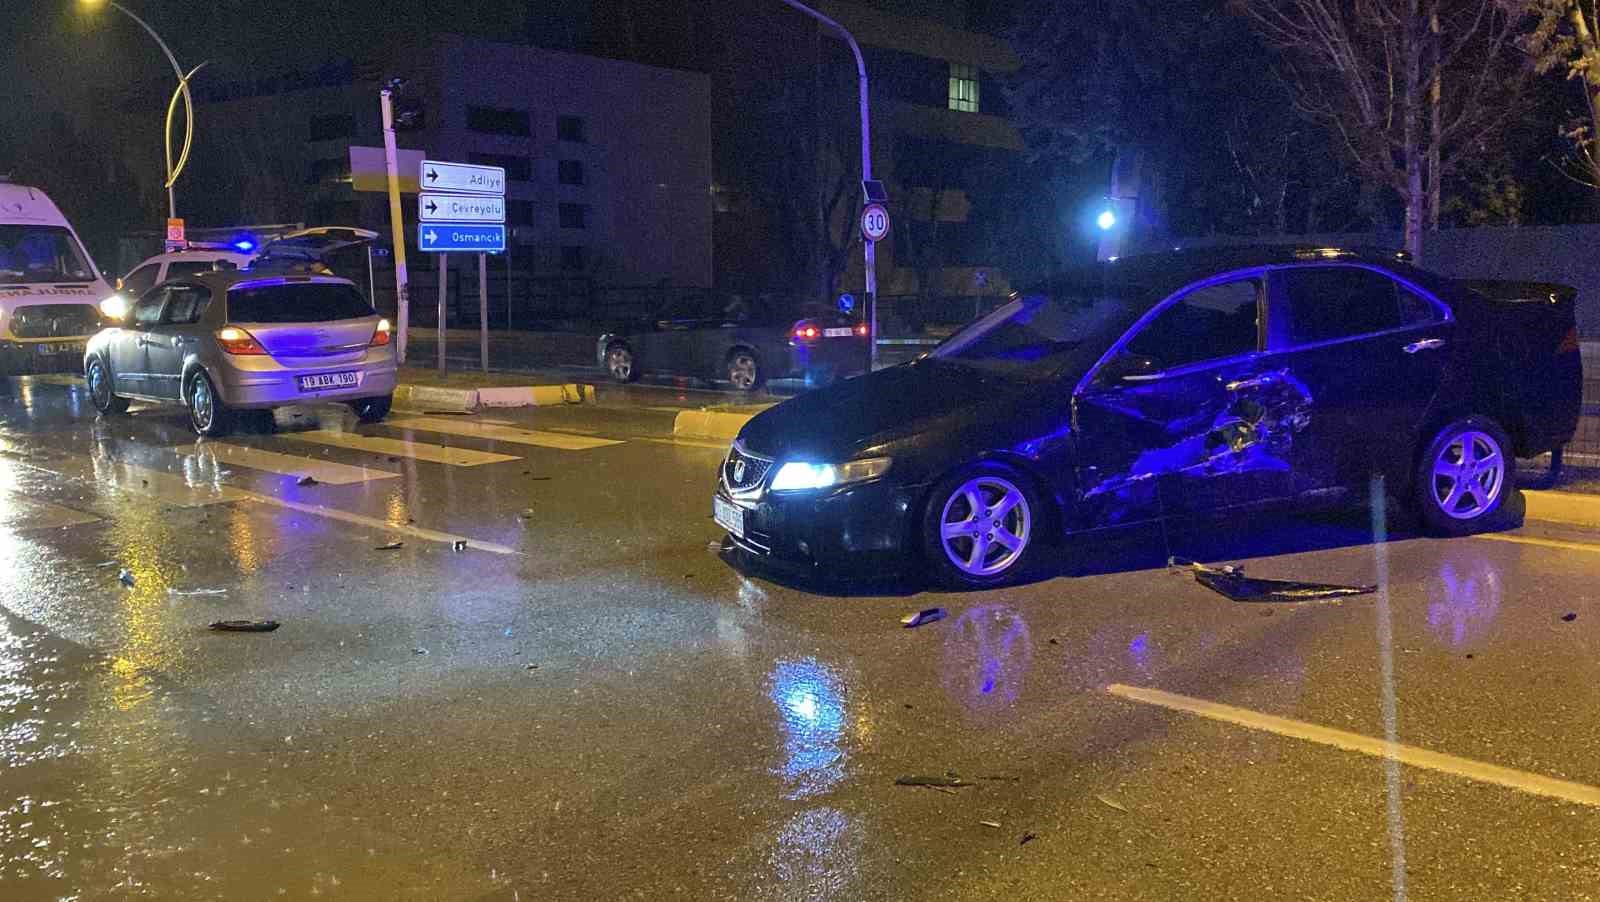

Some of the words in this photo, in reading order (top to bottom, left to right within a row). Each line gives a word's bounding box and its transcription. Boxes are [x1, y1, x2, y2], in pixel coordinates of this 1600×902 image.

[470, 175, 500, 187] Adliye
[452, 202, 501, 215] Çevreyolu
[868, 214, 884, 231] 30
[339, 373, 354, 383] 190
